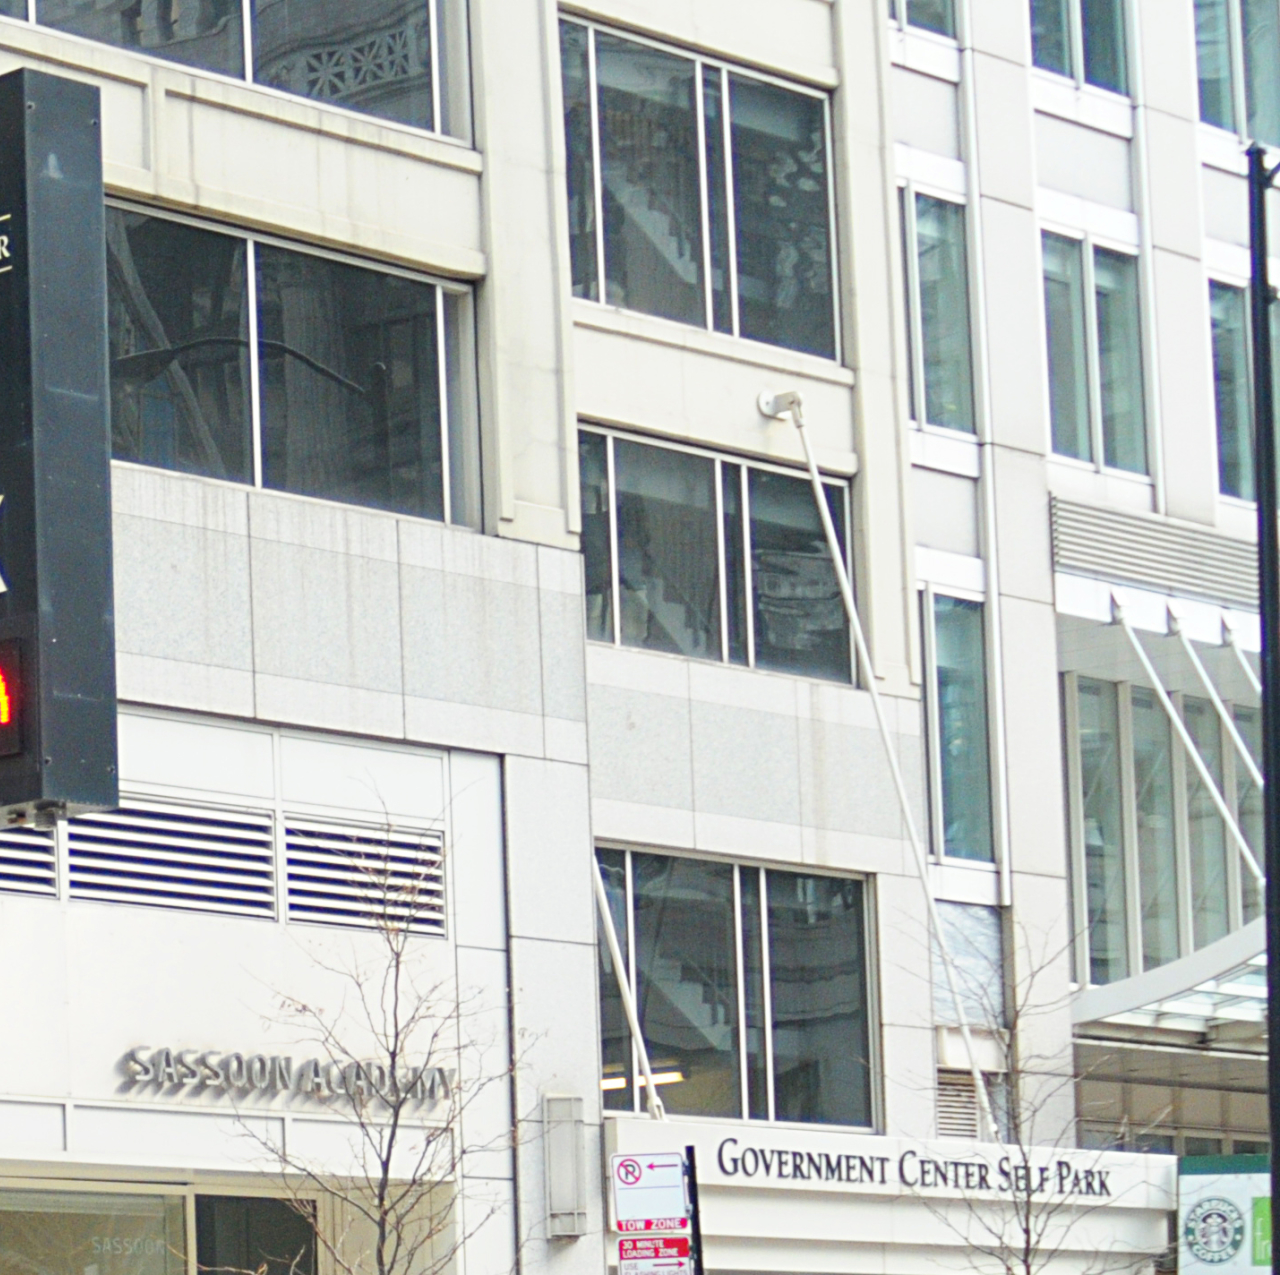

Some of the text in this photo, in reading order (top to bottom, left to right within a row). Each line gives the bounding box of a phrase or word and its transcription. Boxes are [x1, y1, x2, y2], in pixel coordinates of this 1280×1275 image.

[122, 1045, 293, 1092] SASSOON
[717, 1137, 1113, 1197] GOVERNMENT CENTER SELF PARK
[621, 1218, 682, 1231] TOW ZONE
[622, 1239, 665, 1250] 30 MINUTE
[622, 1248, 679, 1259] LOADING ZONE
[1192, 1244, 1237, 1262] COFFEE
[623, 1262, 639, 1271] USE
